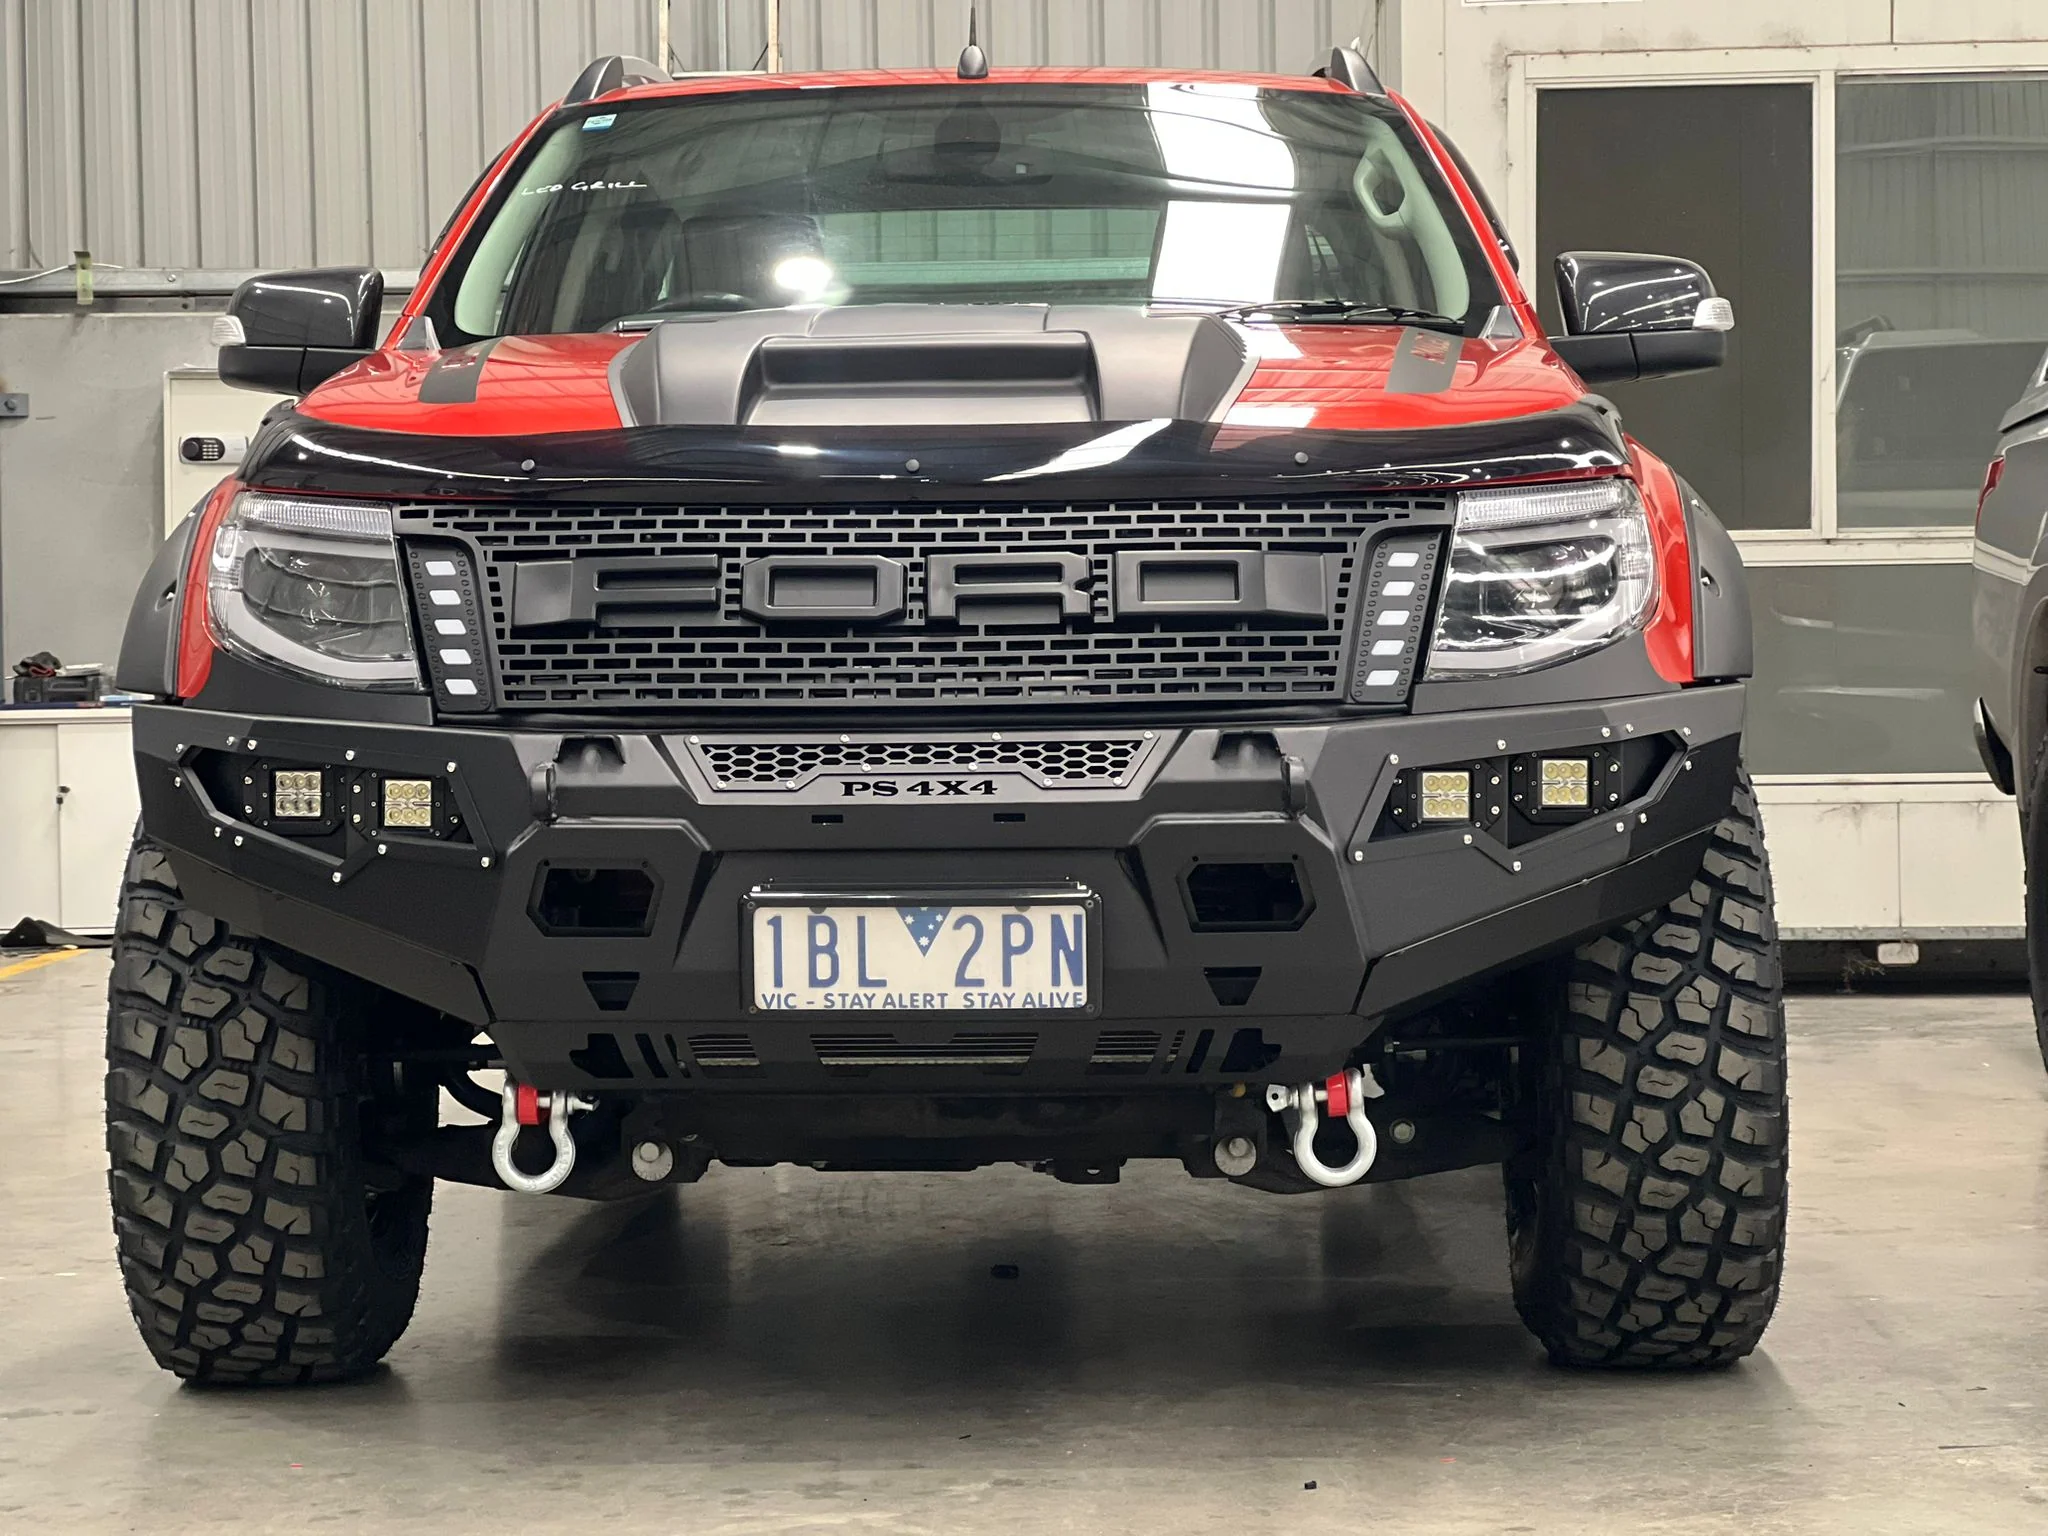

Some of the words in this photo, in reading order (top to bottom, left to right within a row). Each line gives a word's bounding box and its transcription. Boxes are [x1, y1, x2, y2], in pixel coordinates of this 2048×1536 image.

[513, 550, 1328, 629] FORD
[840, 780, 899, 797] PS
[906, 779, 999, 797] 4X4
[766, 914, 888, 989] 1BL
[952, 913, 1084, 988] 2PN
[761, 993, 798, 1010] VIC
[823, 993, 877, 1009] STAY
[883, 993, 949, 1009] ALERT
[962, 992, 1016, 1009] STAY
[1021, 992, 1084, 1009] ALIVE
